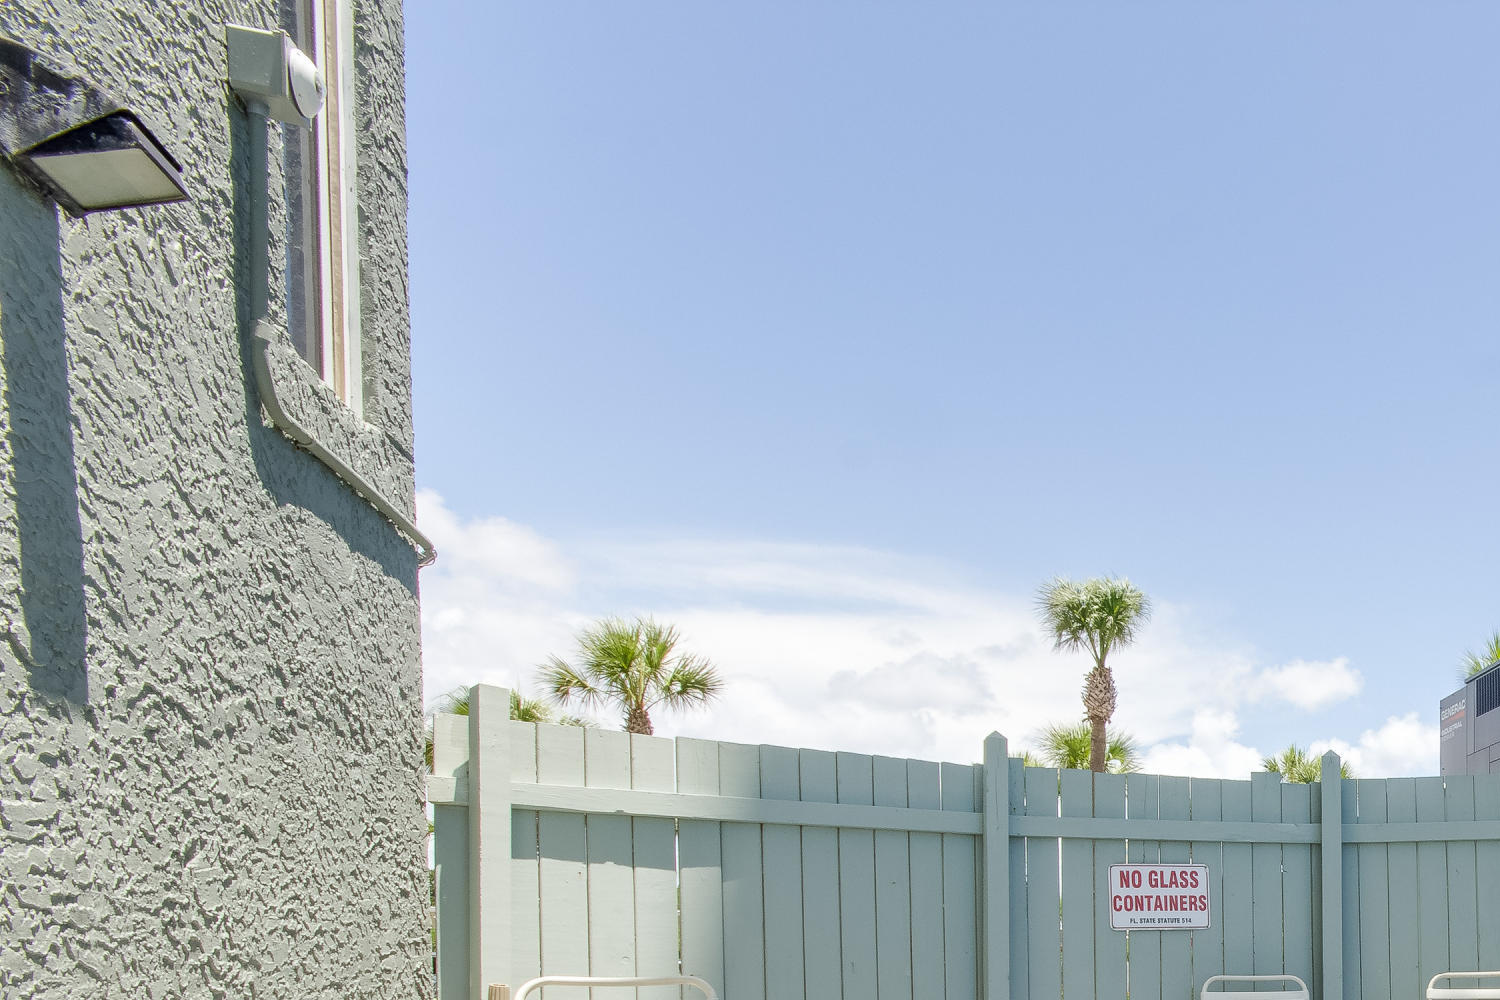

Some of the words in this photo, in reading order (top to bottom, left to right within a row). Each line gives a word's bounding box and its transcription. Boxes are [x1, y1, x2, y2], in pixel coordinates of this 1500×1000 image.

[1120, 870, 1142, 888] NO
[1148, 870, 1199, 888] GLASS
[1113, 895, 1207, 912] CONTAINERS
